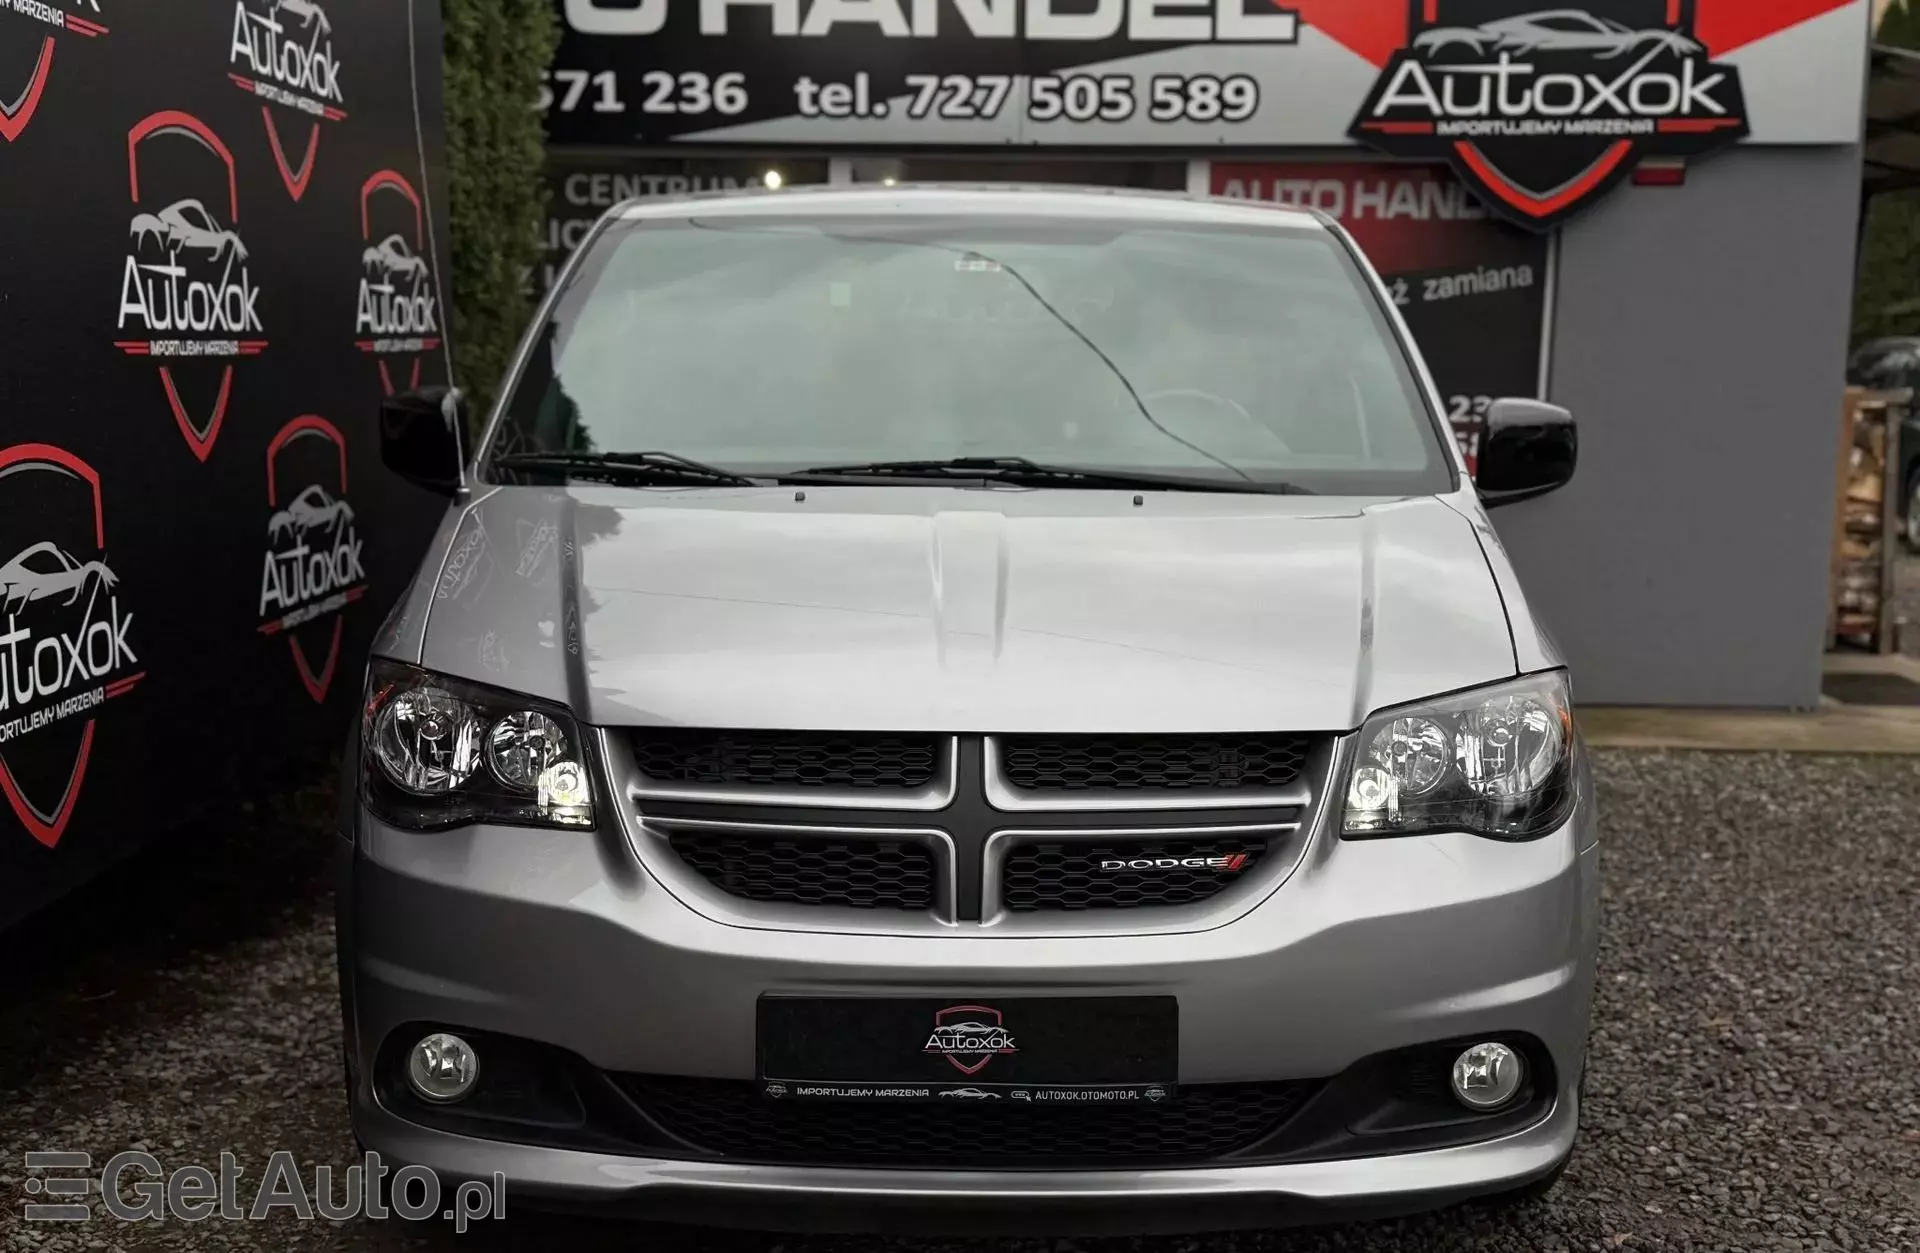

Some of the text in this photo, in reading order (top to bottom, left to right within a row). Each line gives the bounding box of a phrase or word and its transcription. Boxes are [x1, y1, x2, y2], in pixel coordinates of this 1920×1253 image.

[13, 0, 64, 27] MARZENIA
[230, 0, 343, 103] Autoxok
[642, 71, 749, 115] 236
[794, 72, 889, 117] tel.
[905, 75, 1010, 117] 727
[1028, 75, 1135, 120] 505
[1149, 76, 1258, 120] 589
[1372, 51, 1726, 116] Autoxok
[117, 249, 264, 332] Autoxok
[1423, 264, 1534, 301] zamiana
[259, 526, 366, 616] Autoxok
[56, 686, 105, 720] MARZENIA
[1101, 857, 1229, 870] DODGE
[925, 1032, 1016, 1049] Autoxok
[796, 1087, 873, 1097] IMPORTUJEMY
[875, 1088, 930, 1097] MARZENIA
[1035, 1090, 1140, 1100] AUTOXOK.OTOMOTO.PL
